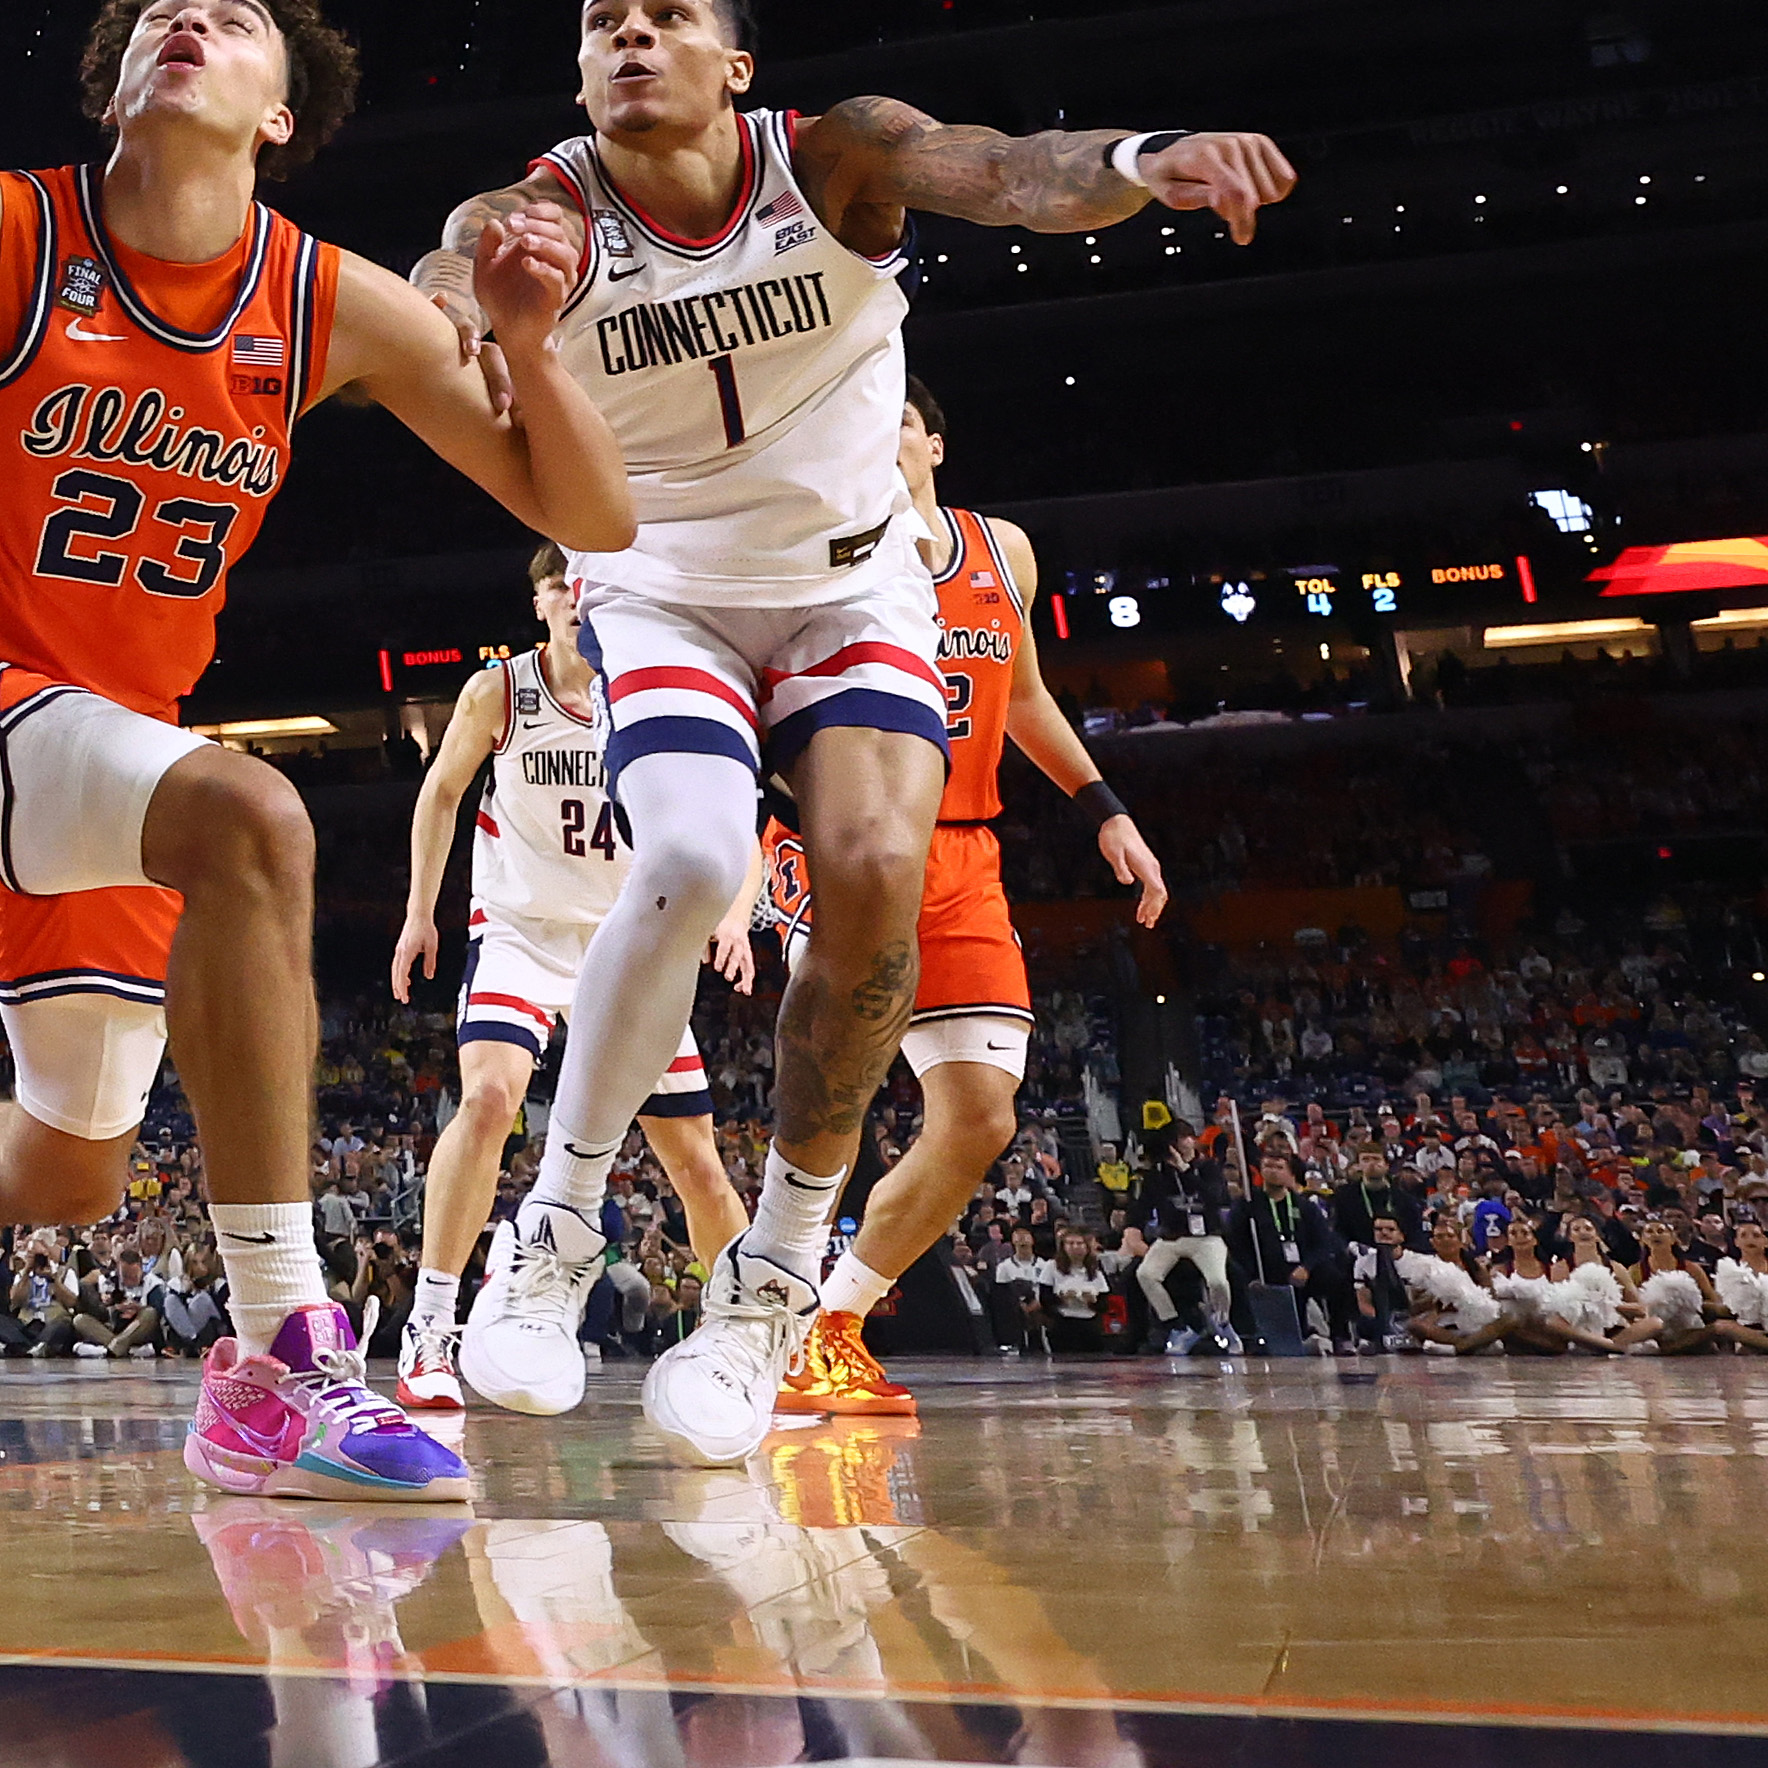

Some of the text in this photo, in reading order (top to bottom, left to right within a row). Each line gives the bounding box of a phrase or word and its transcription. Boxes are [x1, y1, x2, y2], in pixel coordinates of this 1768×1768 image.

[775, 220, 804, 240] BIG
[775, 226, 816, 250] EAST
[68, 264, 101, 285] FINAL
[62, 287, 95, 307] FOUR
[596, 271, 831, 376] CONNECTICUT
[708, 353, 745, 449] 1
[21, 383, 279, 497] Illinois
[32, 467, 240, 599] 23
[1295, 564, 1504, 595] TOL FLS BONUS
[1109, 596, 1140, 627] 8
[1306, 587, 1396, 617] 4 2
[403, 645, 511, 666] BONUS FLS
[561, 799, 616, 861] 24
